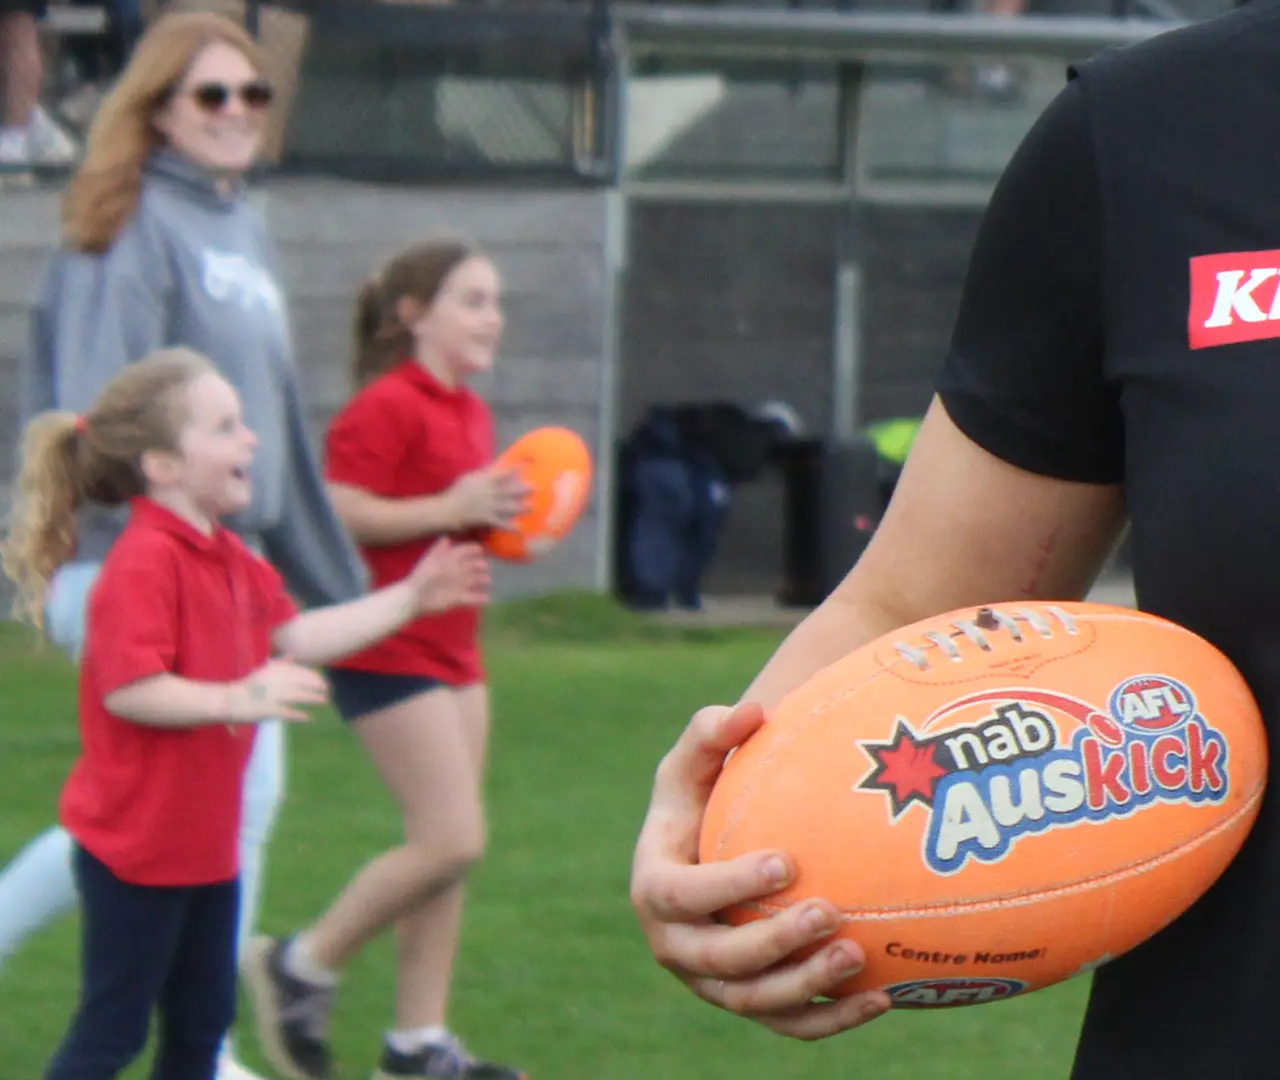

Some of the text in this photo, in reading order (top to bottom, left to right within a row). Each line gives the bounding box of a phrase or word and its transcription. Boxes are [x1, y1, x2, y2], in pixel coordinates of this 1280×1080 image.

[1120, 684, 1191, 724] AFL
[945, 709, 1051, 770] nab
[885, 941, 967, 965] Centre
[901, 986, 1008, 1005] AFL
